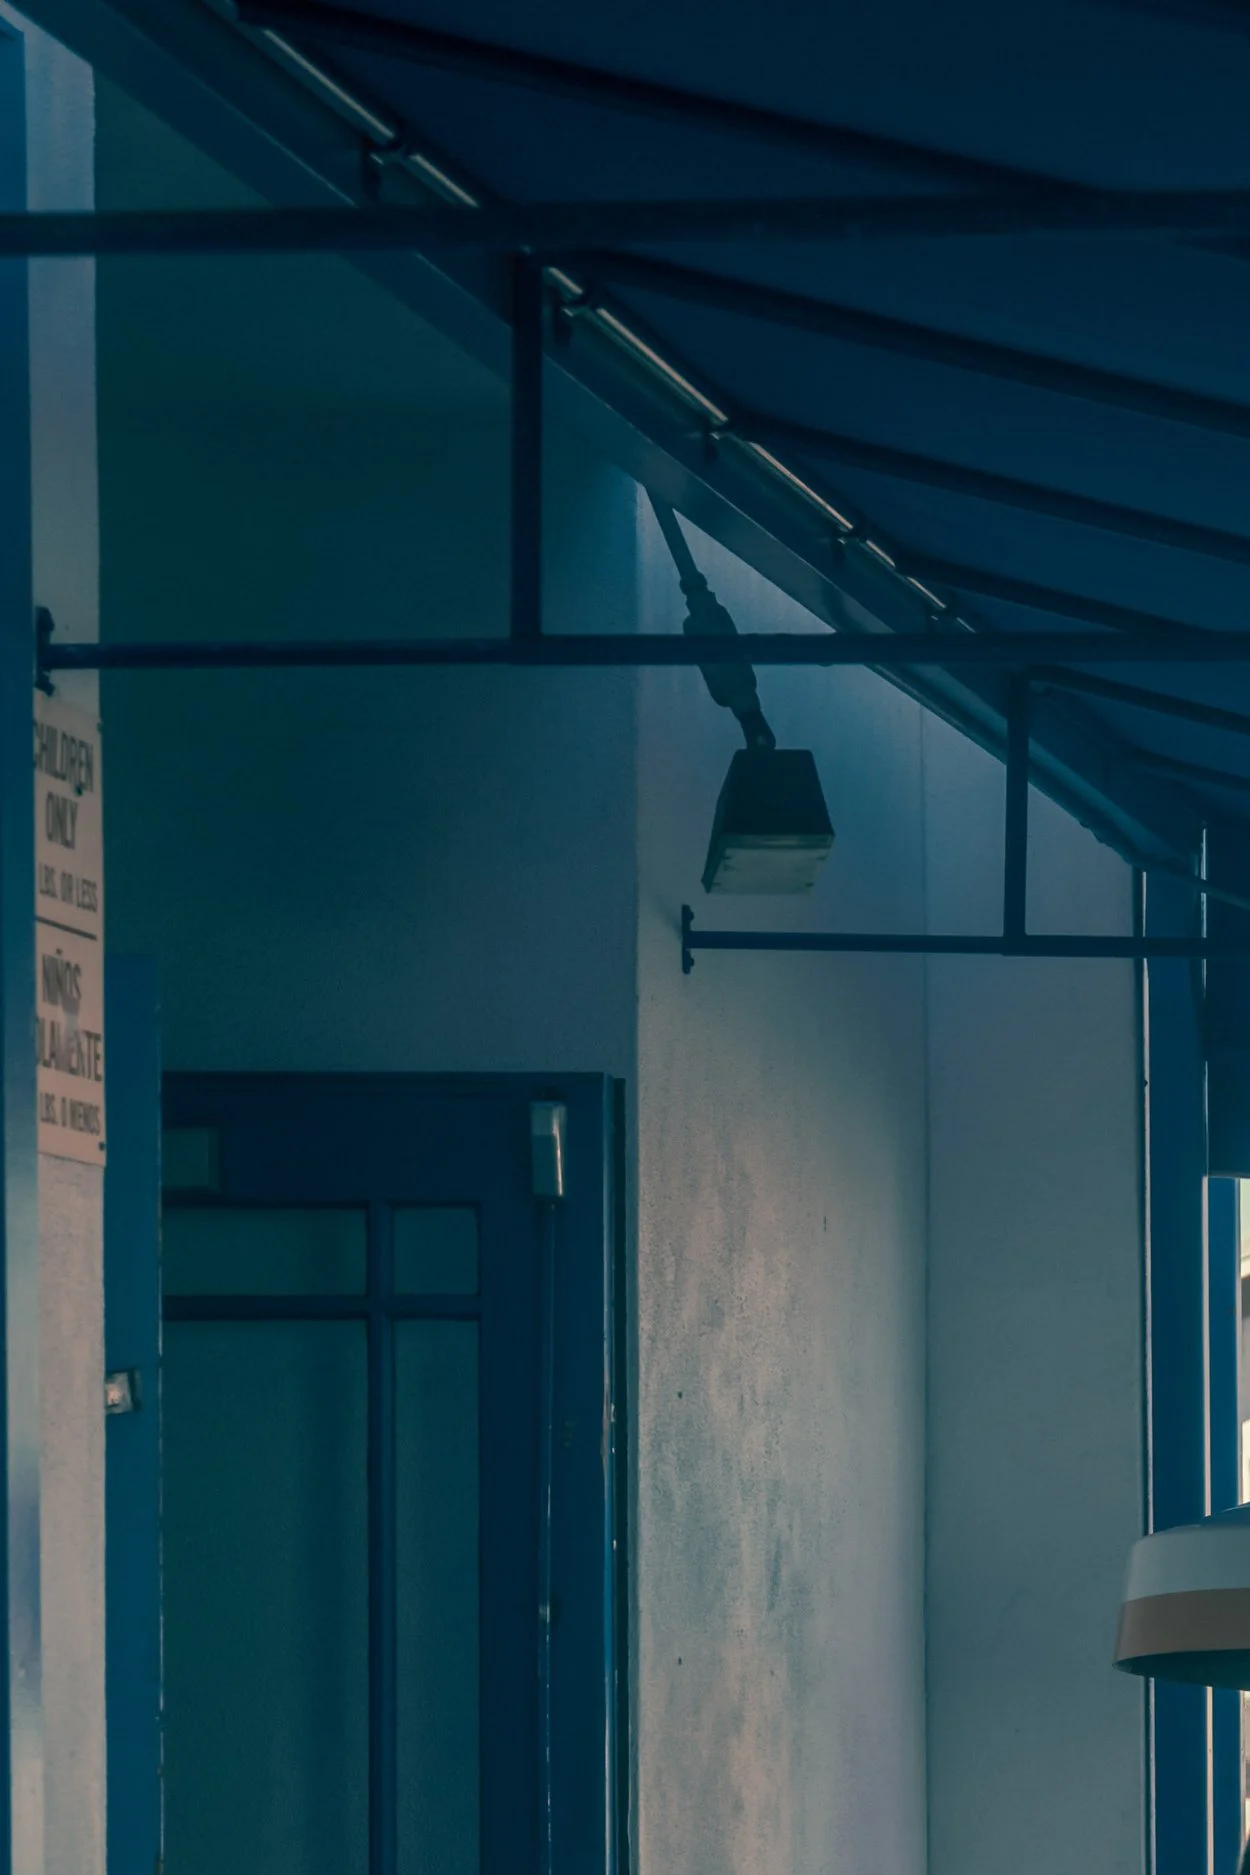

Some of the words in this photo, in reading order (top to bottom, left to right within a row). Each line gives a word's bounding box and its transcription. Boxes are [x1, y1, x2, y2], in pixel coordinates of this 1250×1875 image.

[46, 791, 78, 850] ONLY
[61, 870, 74, 904] OR
[76, 877, 98, 913] LESS
[42, 948, 82, 1010] NIÑOS
[69, 1099, 101, 1136] MENOS
